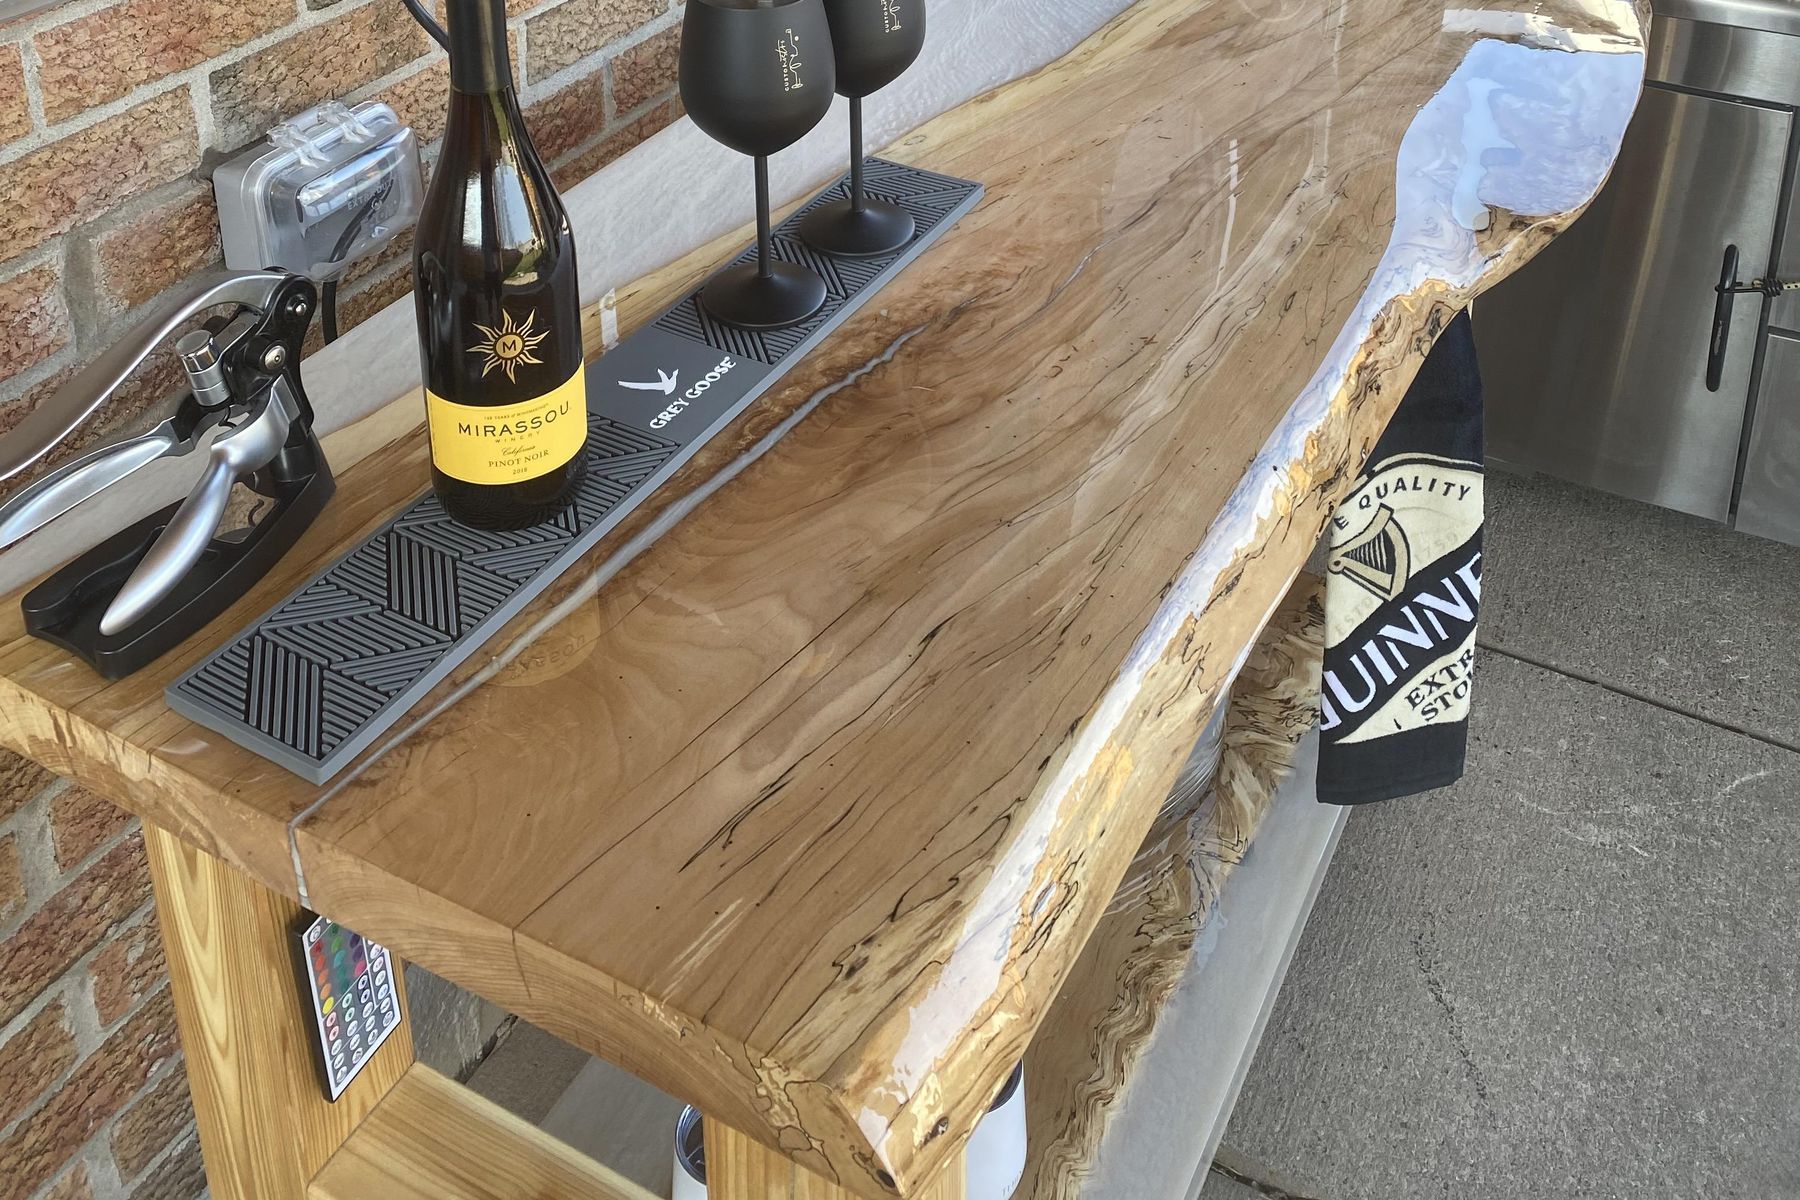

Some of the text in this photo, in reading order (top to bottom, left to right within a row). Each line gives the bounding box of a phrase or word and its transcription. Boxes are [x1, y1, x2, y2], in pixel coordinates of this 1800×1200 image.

[502, 339, 517, 354] M
[649, 356, 737, 429] GREY GOOSE
[458, 400, 570, 437] MIRASSOU
[495, 430, 541, 443] WINERY
[488, 449, 549, 468] PINOT NOIR
[1358, 475, 1471, 510] QUALITY
[1420, 671, 1474, 722] STO
